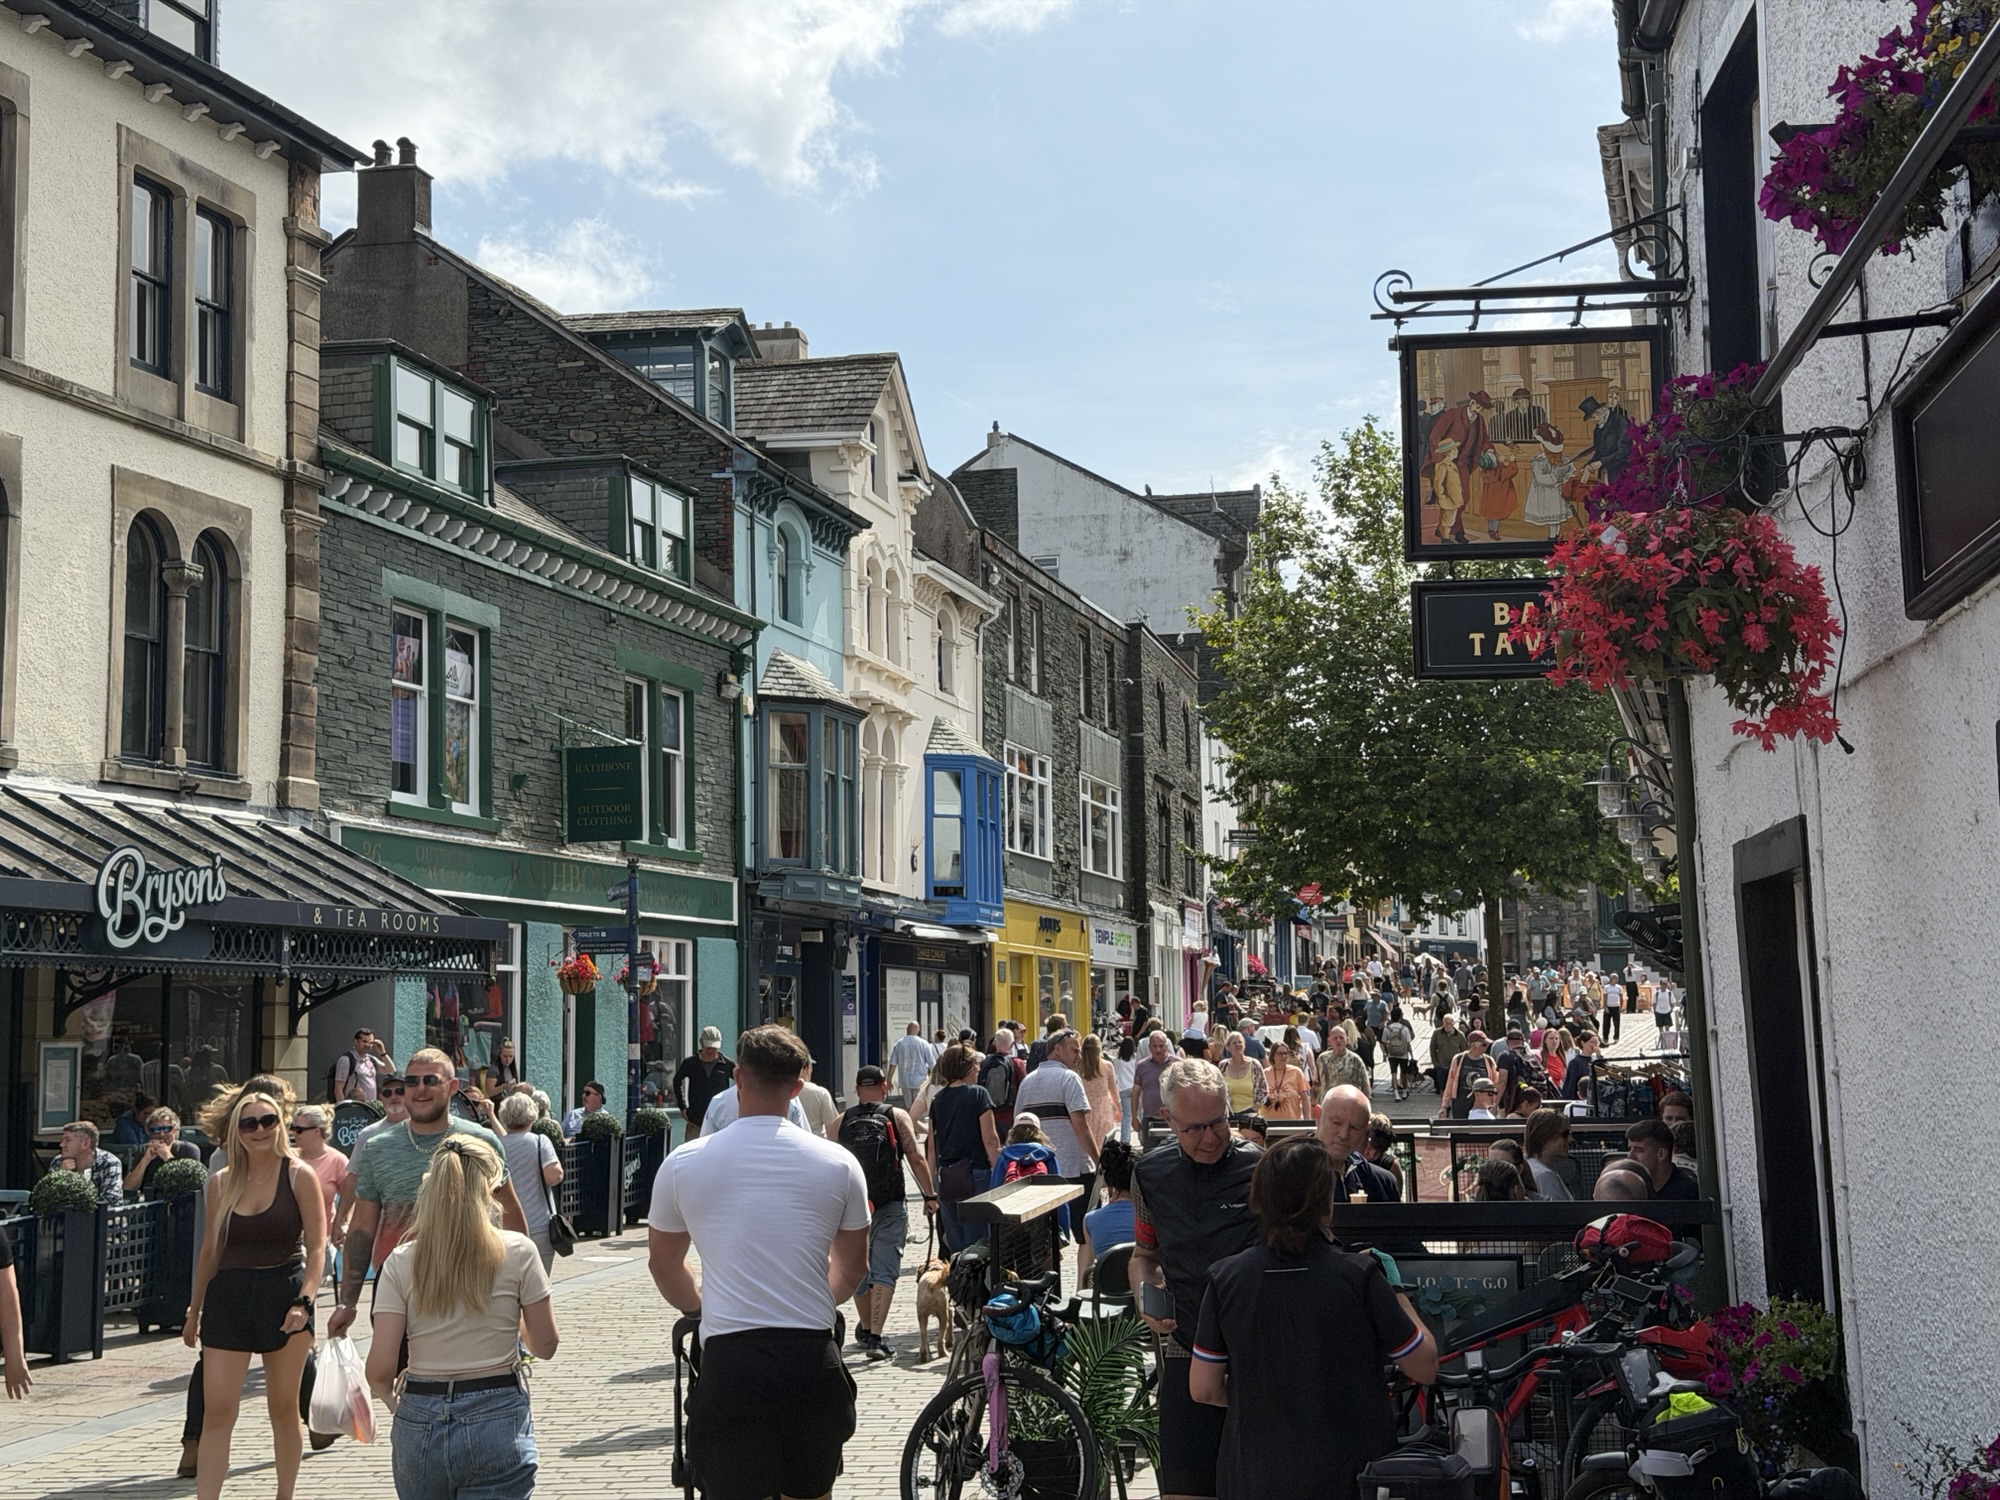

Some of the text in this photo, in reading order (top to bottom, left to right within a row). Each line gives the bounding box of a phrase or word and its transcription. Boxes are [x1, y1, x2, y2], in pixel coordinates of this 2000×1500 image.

[1492, 600, 1569, 627] BA
[1468, 631, 1558, 657] TAV
[575, 761, 634, 774] RATHBONE
[577, 803, 632, 815] OUTDOOR
[576, 815, 633, 827] CLOTHING
[97, 846, 227, 949] Bryson's
[314, 908, 440, 935] & TEA ROOMS
[1095, 928, 1114, 946] TEMPLE
[782, 946, 794, 956] TREE
